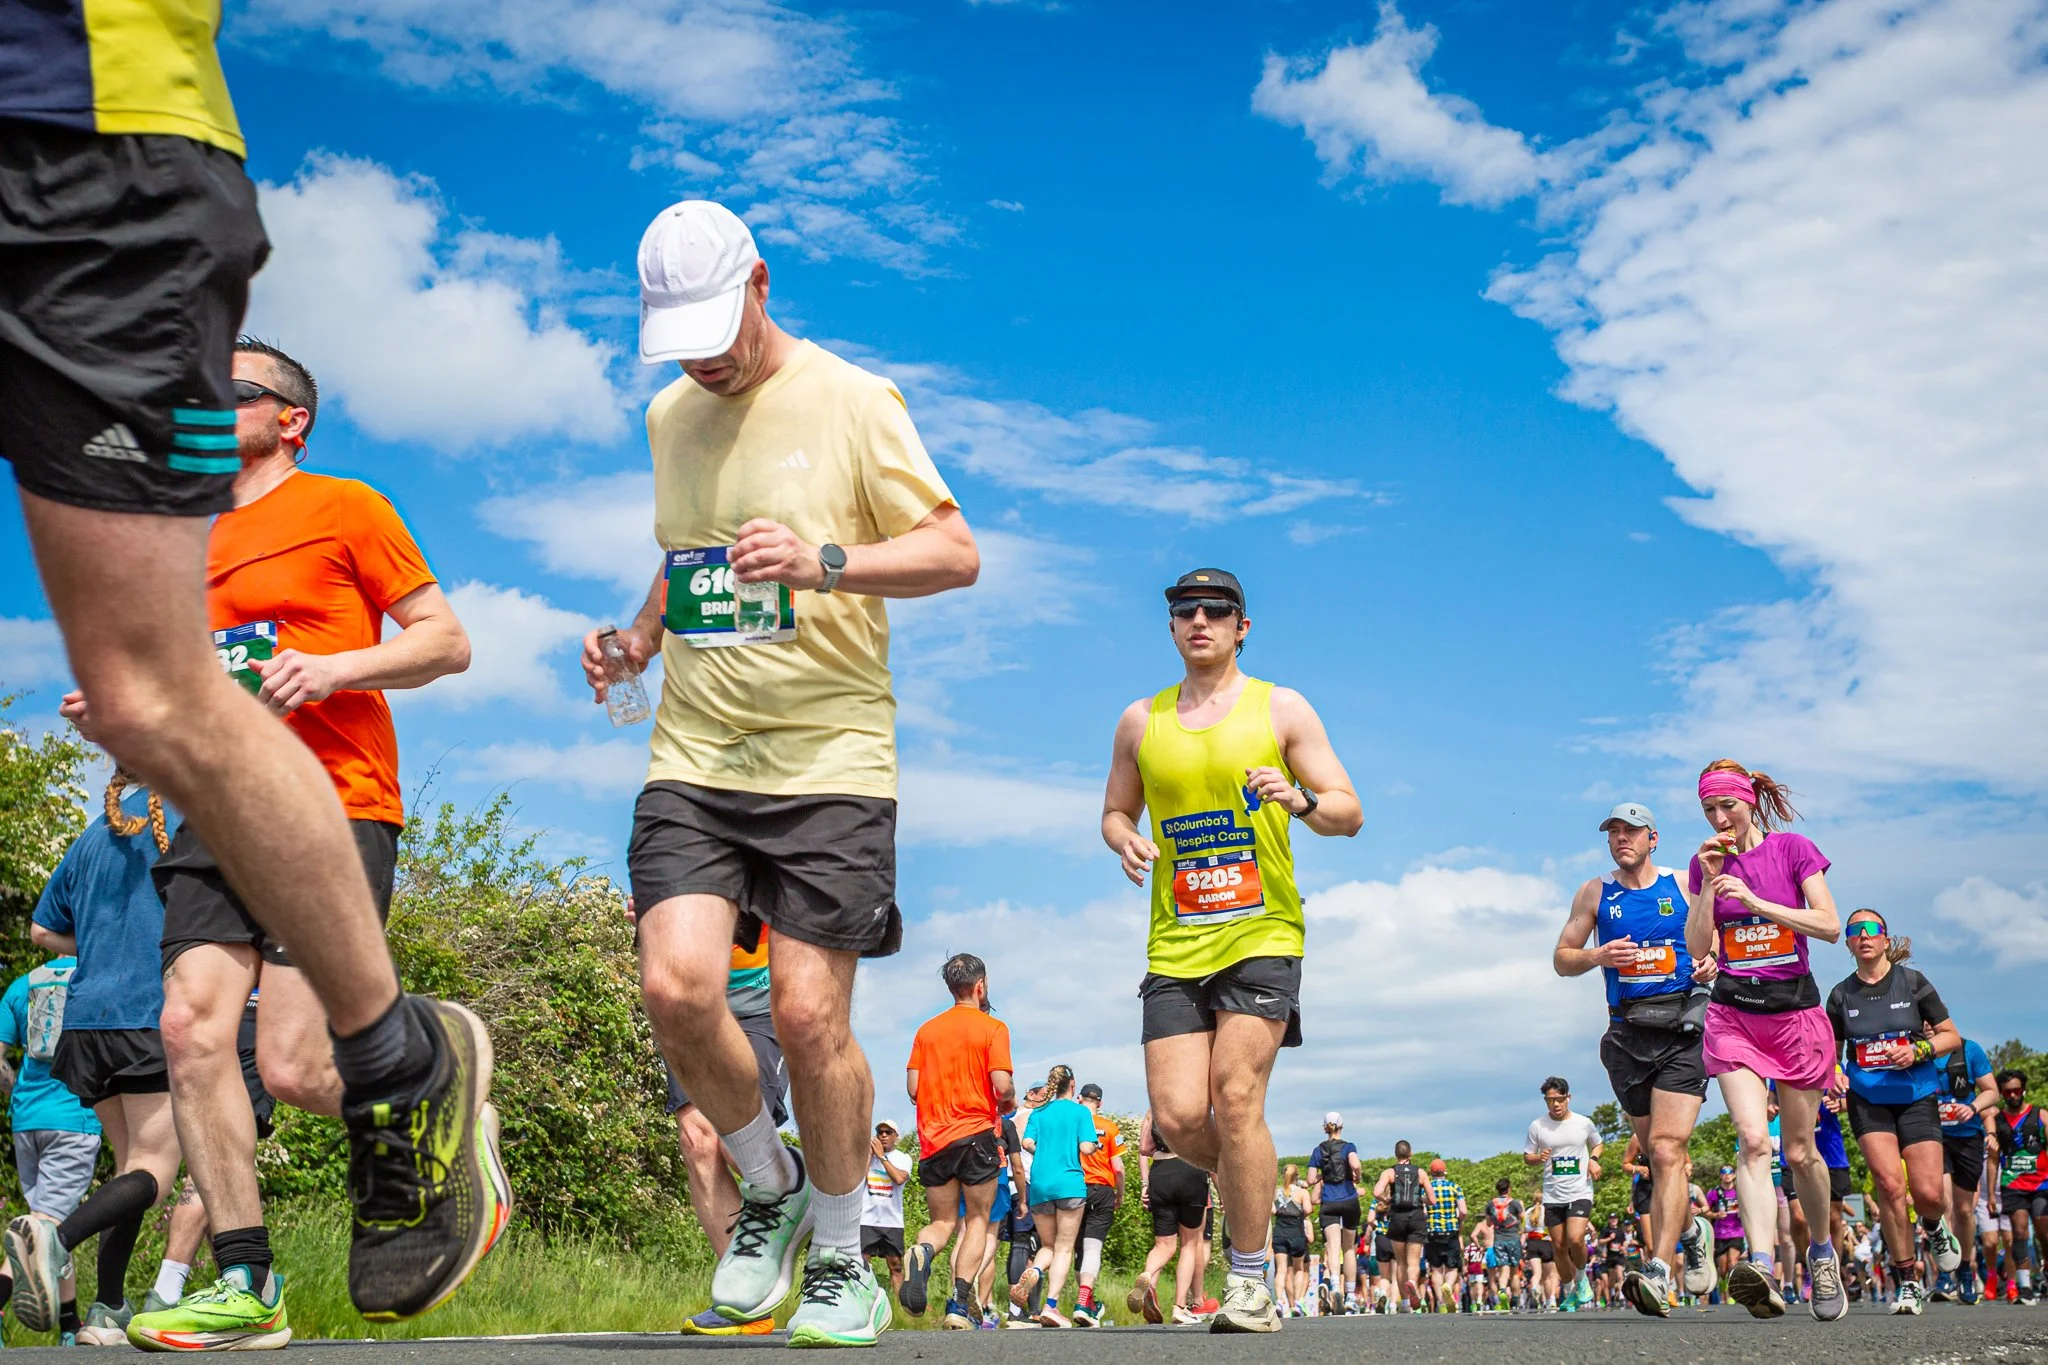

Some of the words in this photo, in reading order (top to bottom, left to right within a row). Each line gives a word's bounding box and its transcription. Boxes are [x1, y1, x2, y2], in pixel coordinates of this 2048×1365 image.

[82, 443, 149, 463] adidas
[1173, 814, 1229, 832] Columba's
[1176, 833, 1216, 848] Hospice
[1217, 831, 1249, 842] Care
[1185, 865, 1243, 892] 9205
[1198, 890, 1236, 904] AARON
[1609, 904, 1622, 920] PG
[1734, 924, 1780, 943] 8625
[1745, 943, 1771, 953] EMILY
[1636, 963, 1656, 971] PAUL
[1733, 994, 1765, 1004] SALOMON
